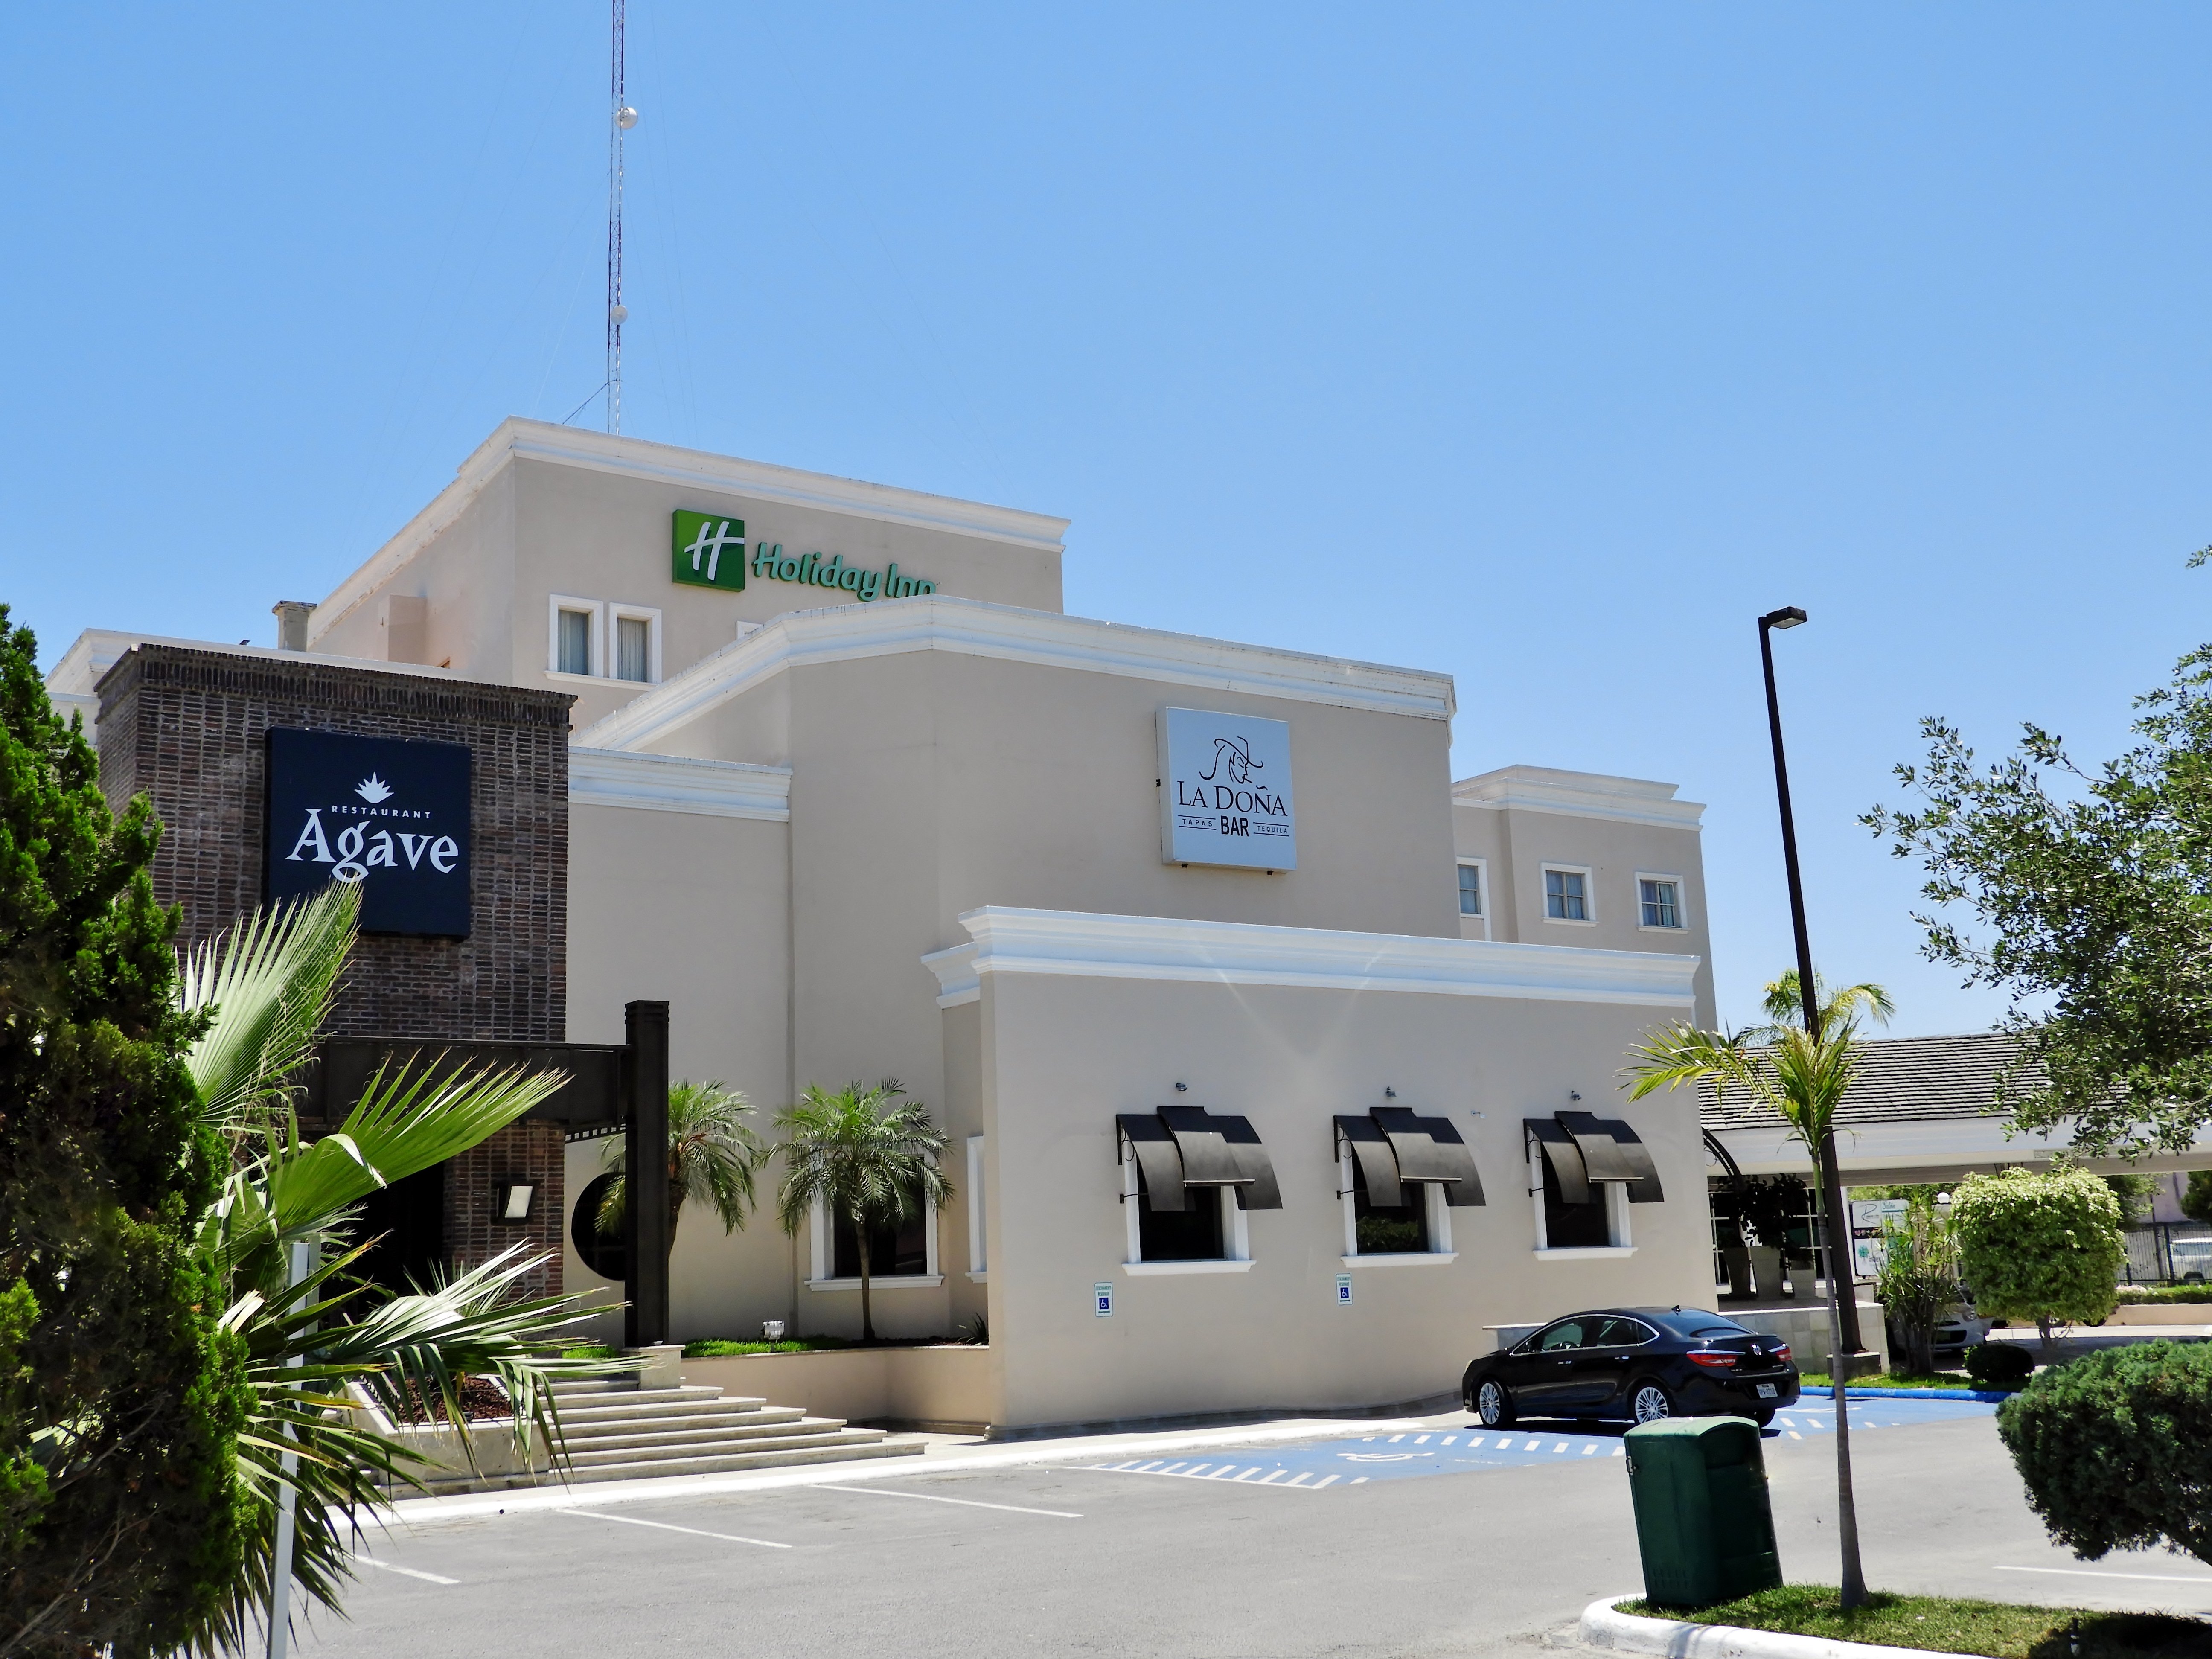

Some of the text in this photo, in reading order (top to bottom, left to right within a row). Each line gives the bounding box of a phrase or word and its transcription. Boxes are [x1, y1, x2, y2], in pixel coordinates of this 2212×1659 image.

[751, 542, 936, 602] Holiday Inn
[332, 805, 431, 819] RESTAURANT
[1176, 780, 1288, 816] LA DOÑA
[1182, 815, 1288, 837] TAPAS BAR TEQUILA
[285, 808, 459, 883] Agave
